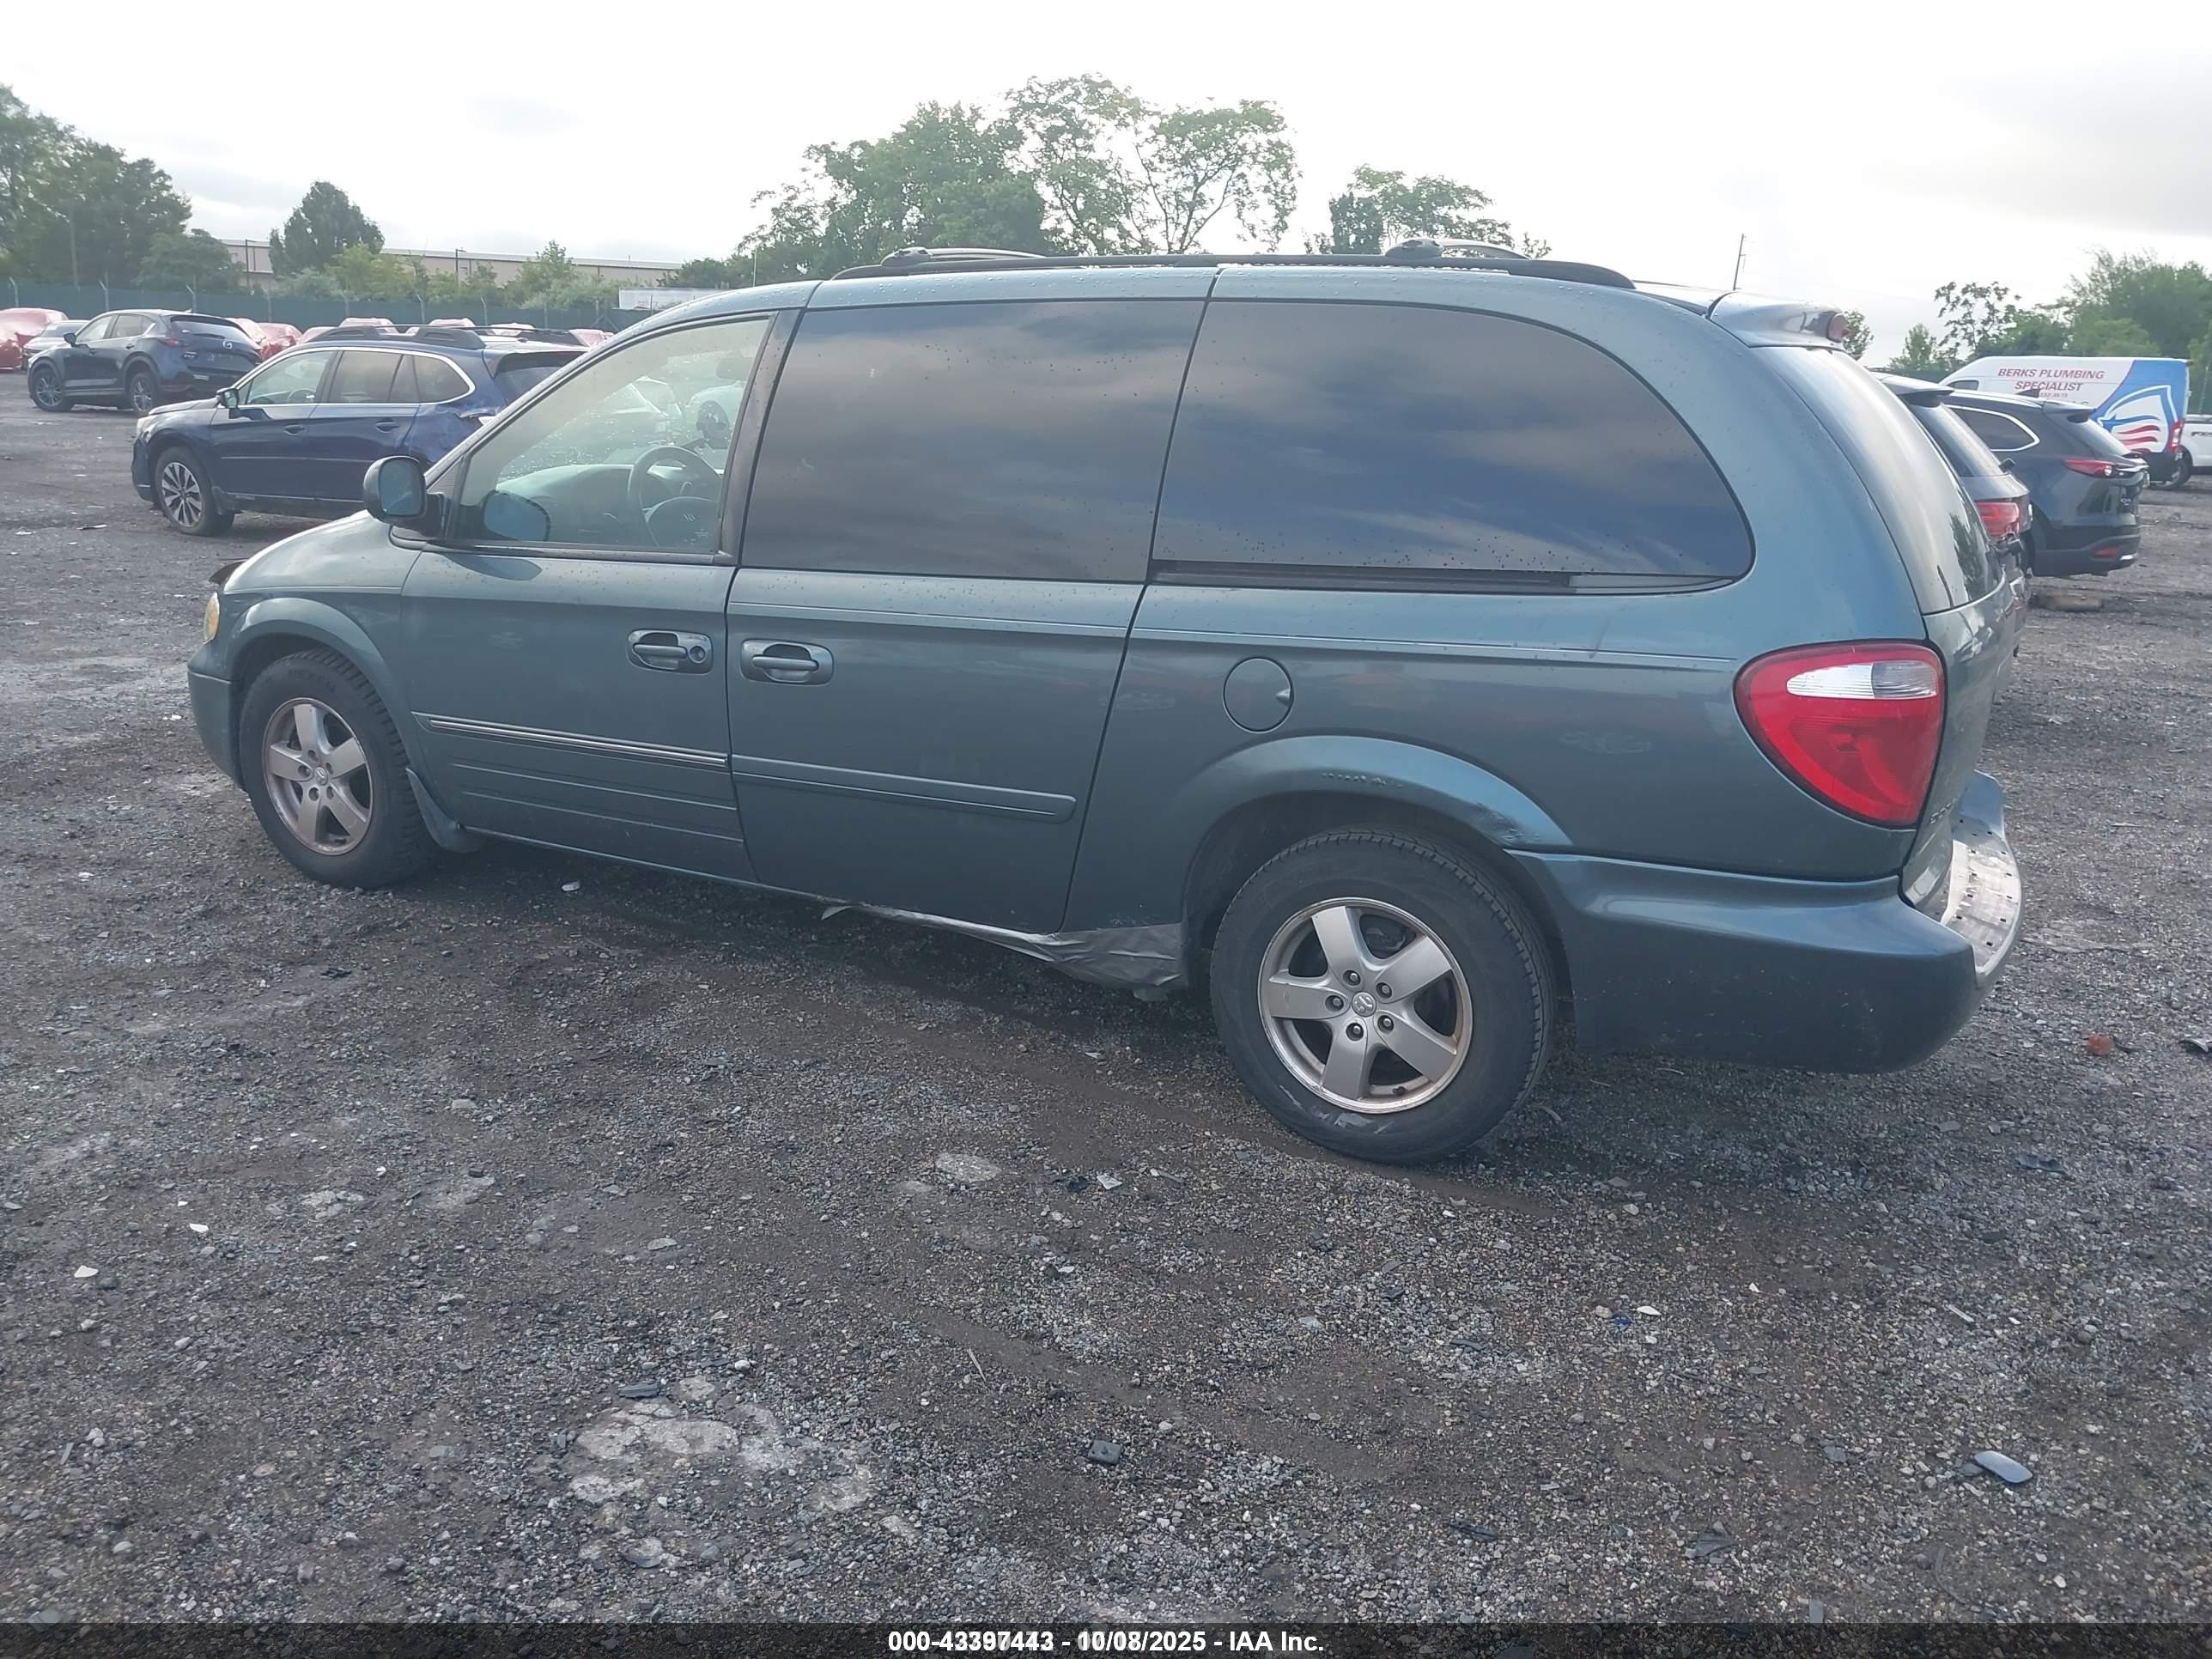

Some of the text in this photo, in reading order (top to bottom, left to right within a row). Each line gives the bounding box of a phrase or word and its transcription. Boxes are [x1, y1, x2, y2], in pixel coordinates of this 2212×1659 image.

[1998, 368, 2106, 379] BERKS PLUMBING
[2014, 380, 2084, 392] SPECIALIST
